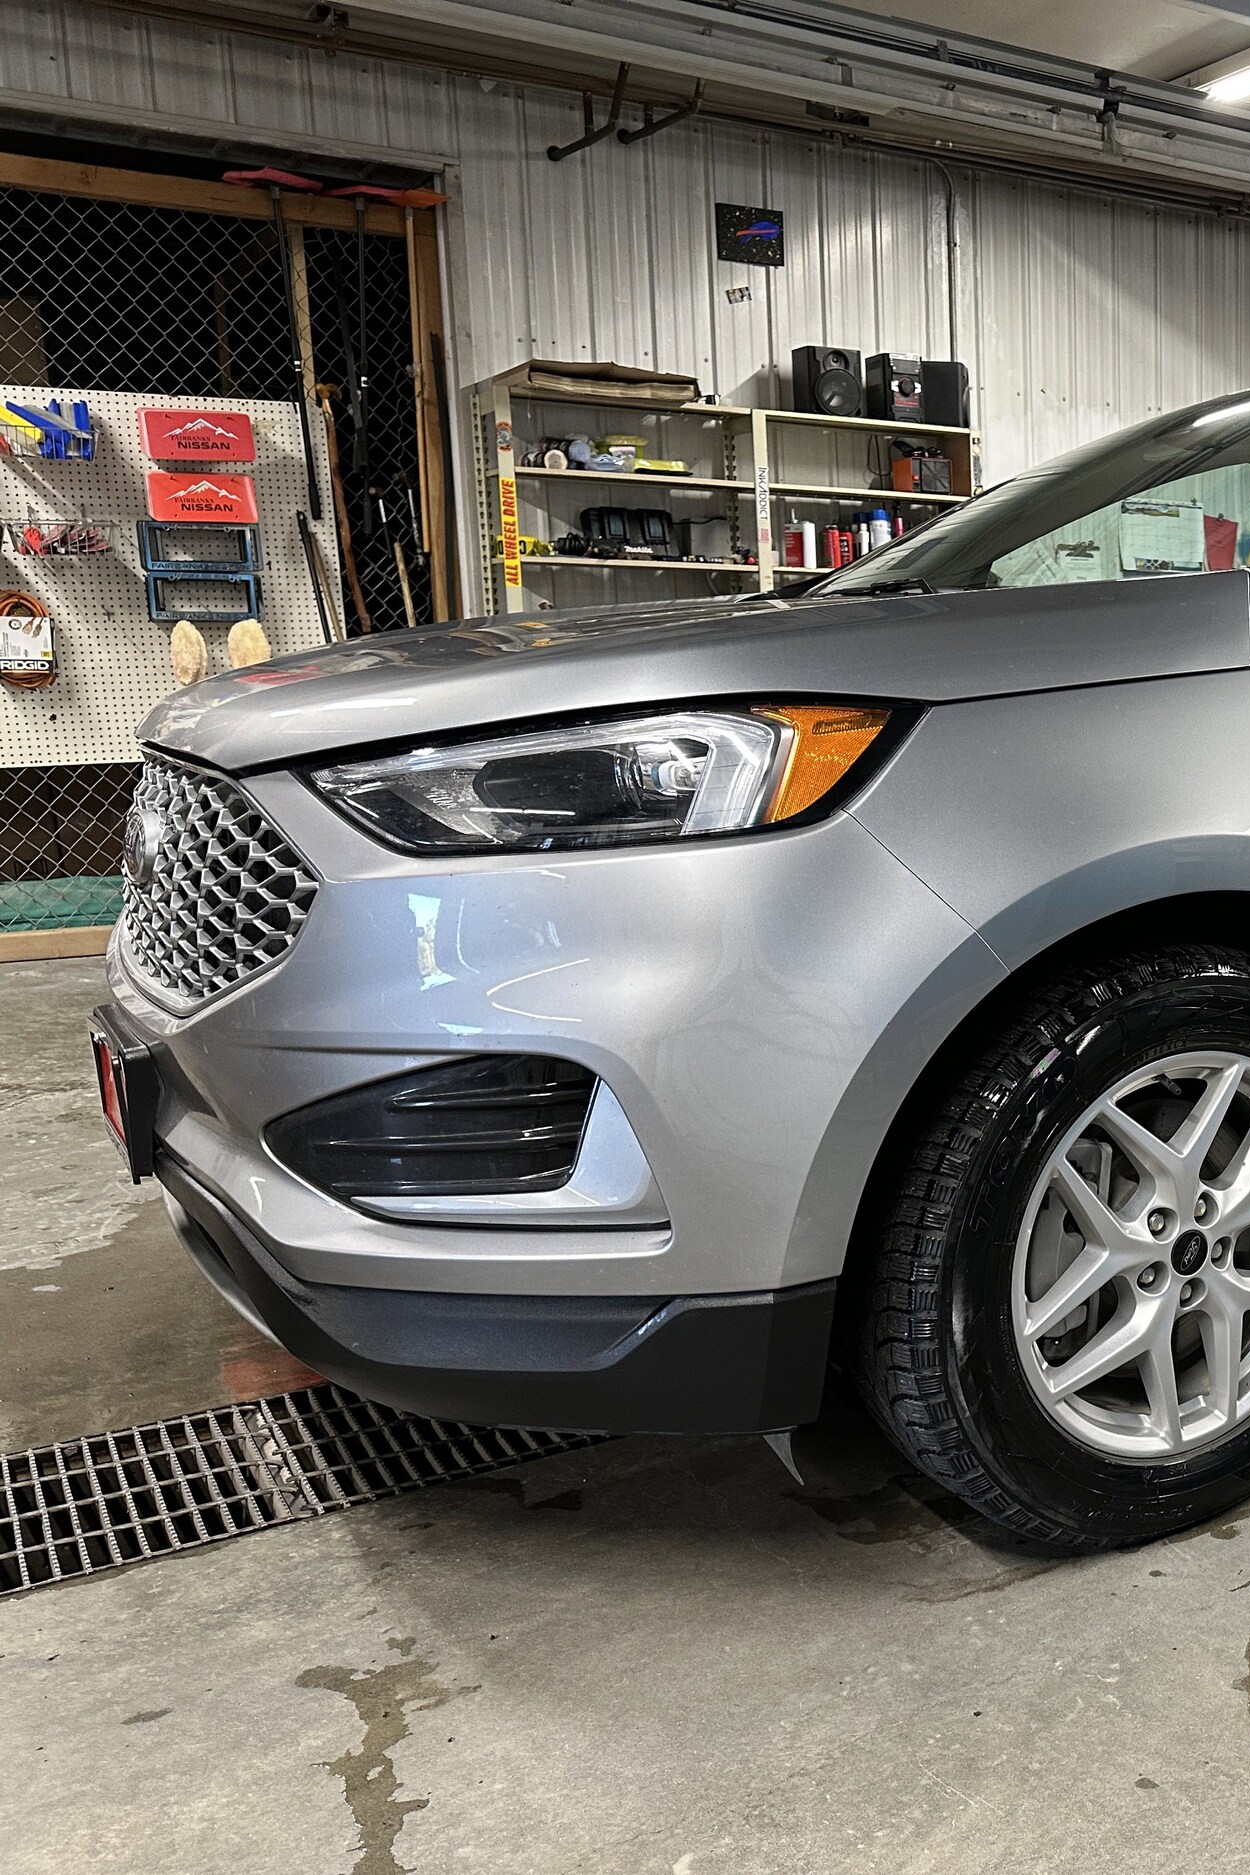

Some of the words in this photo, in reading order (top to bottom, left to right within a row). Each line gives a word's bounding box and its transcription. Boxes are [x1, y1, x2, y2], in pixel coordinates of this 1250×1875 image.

[177, 441, 231, 450] NISSAN
[181, 503, 234, 512] NISSAN
[502, 479, 515, 517] DRIVE
[504, 521, 518, 560] WHEEL
[505, 565, 519, 585] ALL
[0, 661, 50, 670] RIDGID
[969, 1055, 1079, 1232] TOYO
[1184, 1241, 1199, 1265] Ford
